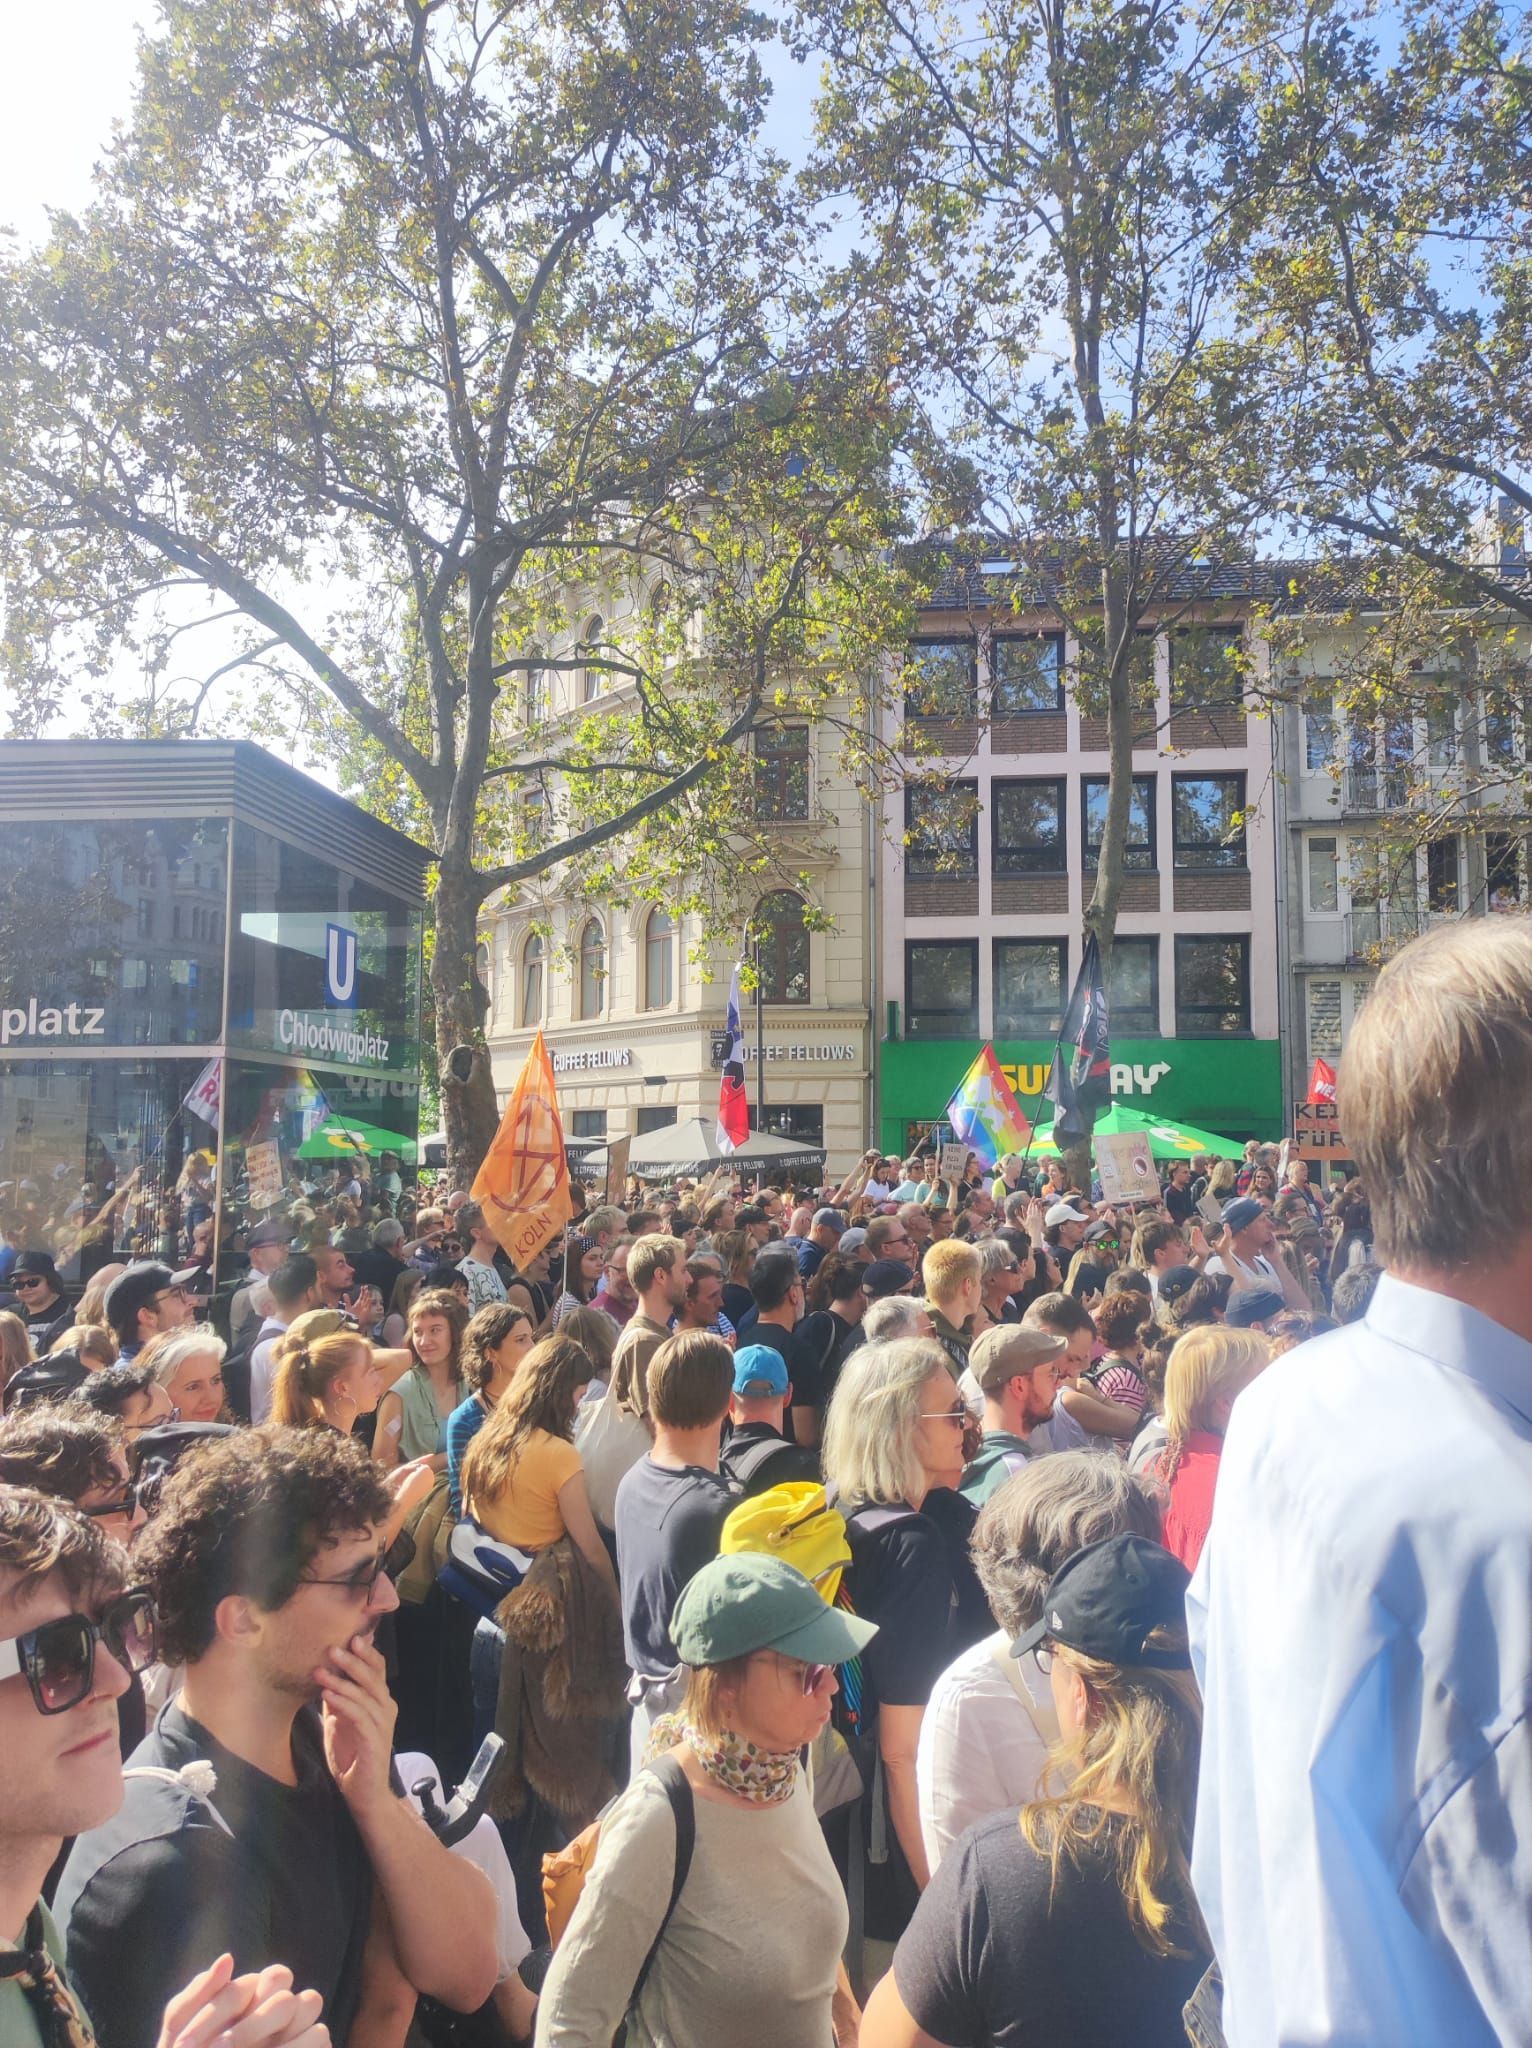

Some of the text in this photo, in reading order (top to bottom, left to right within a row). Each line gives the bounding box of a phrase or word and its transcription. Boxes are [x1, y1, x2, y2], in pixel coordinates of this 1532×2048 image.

[329, 928, 355, 1000] U
[2, 998, 105, 1044] platz
[280, 1008, 389, 1063] Chlodwigplatz
[553, 1047, 630, 1072] COFFEE FELLOWS
[742, 1044, 855, 1061] OFEE FELLOWS
[1000, 1060, 1171, 1095] SUAY
[1296, 1103, 1339, 1119] KEI
[743, 1160, 766, 1171] FELLOWS
[515, 1212, 552, 1258] KÖLN
